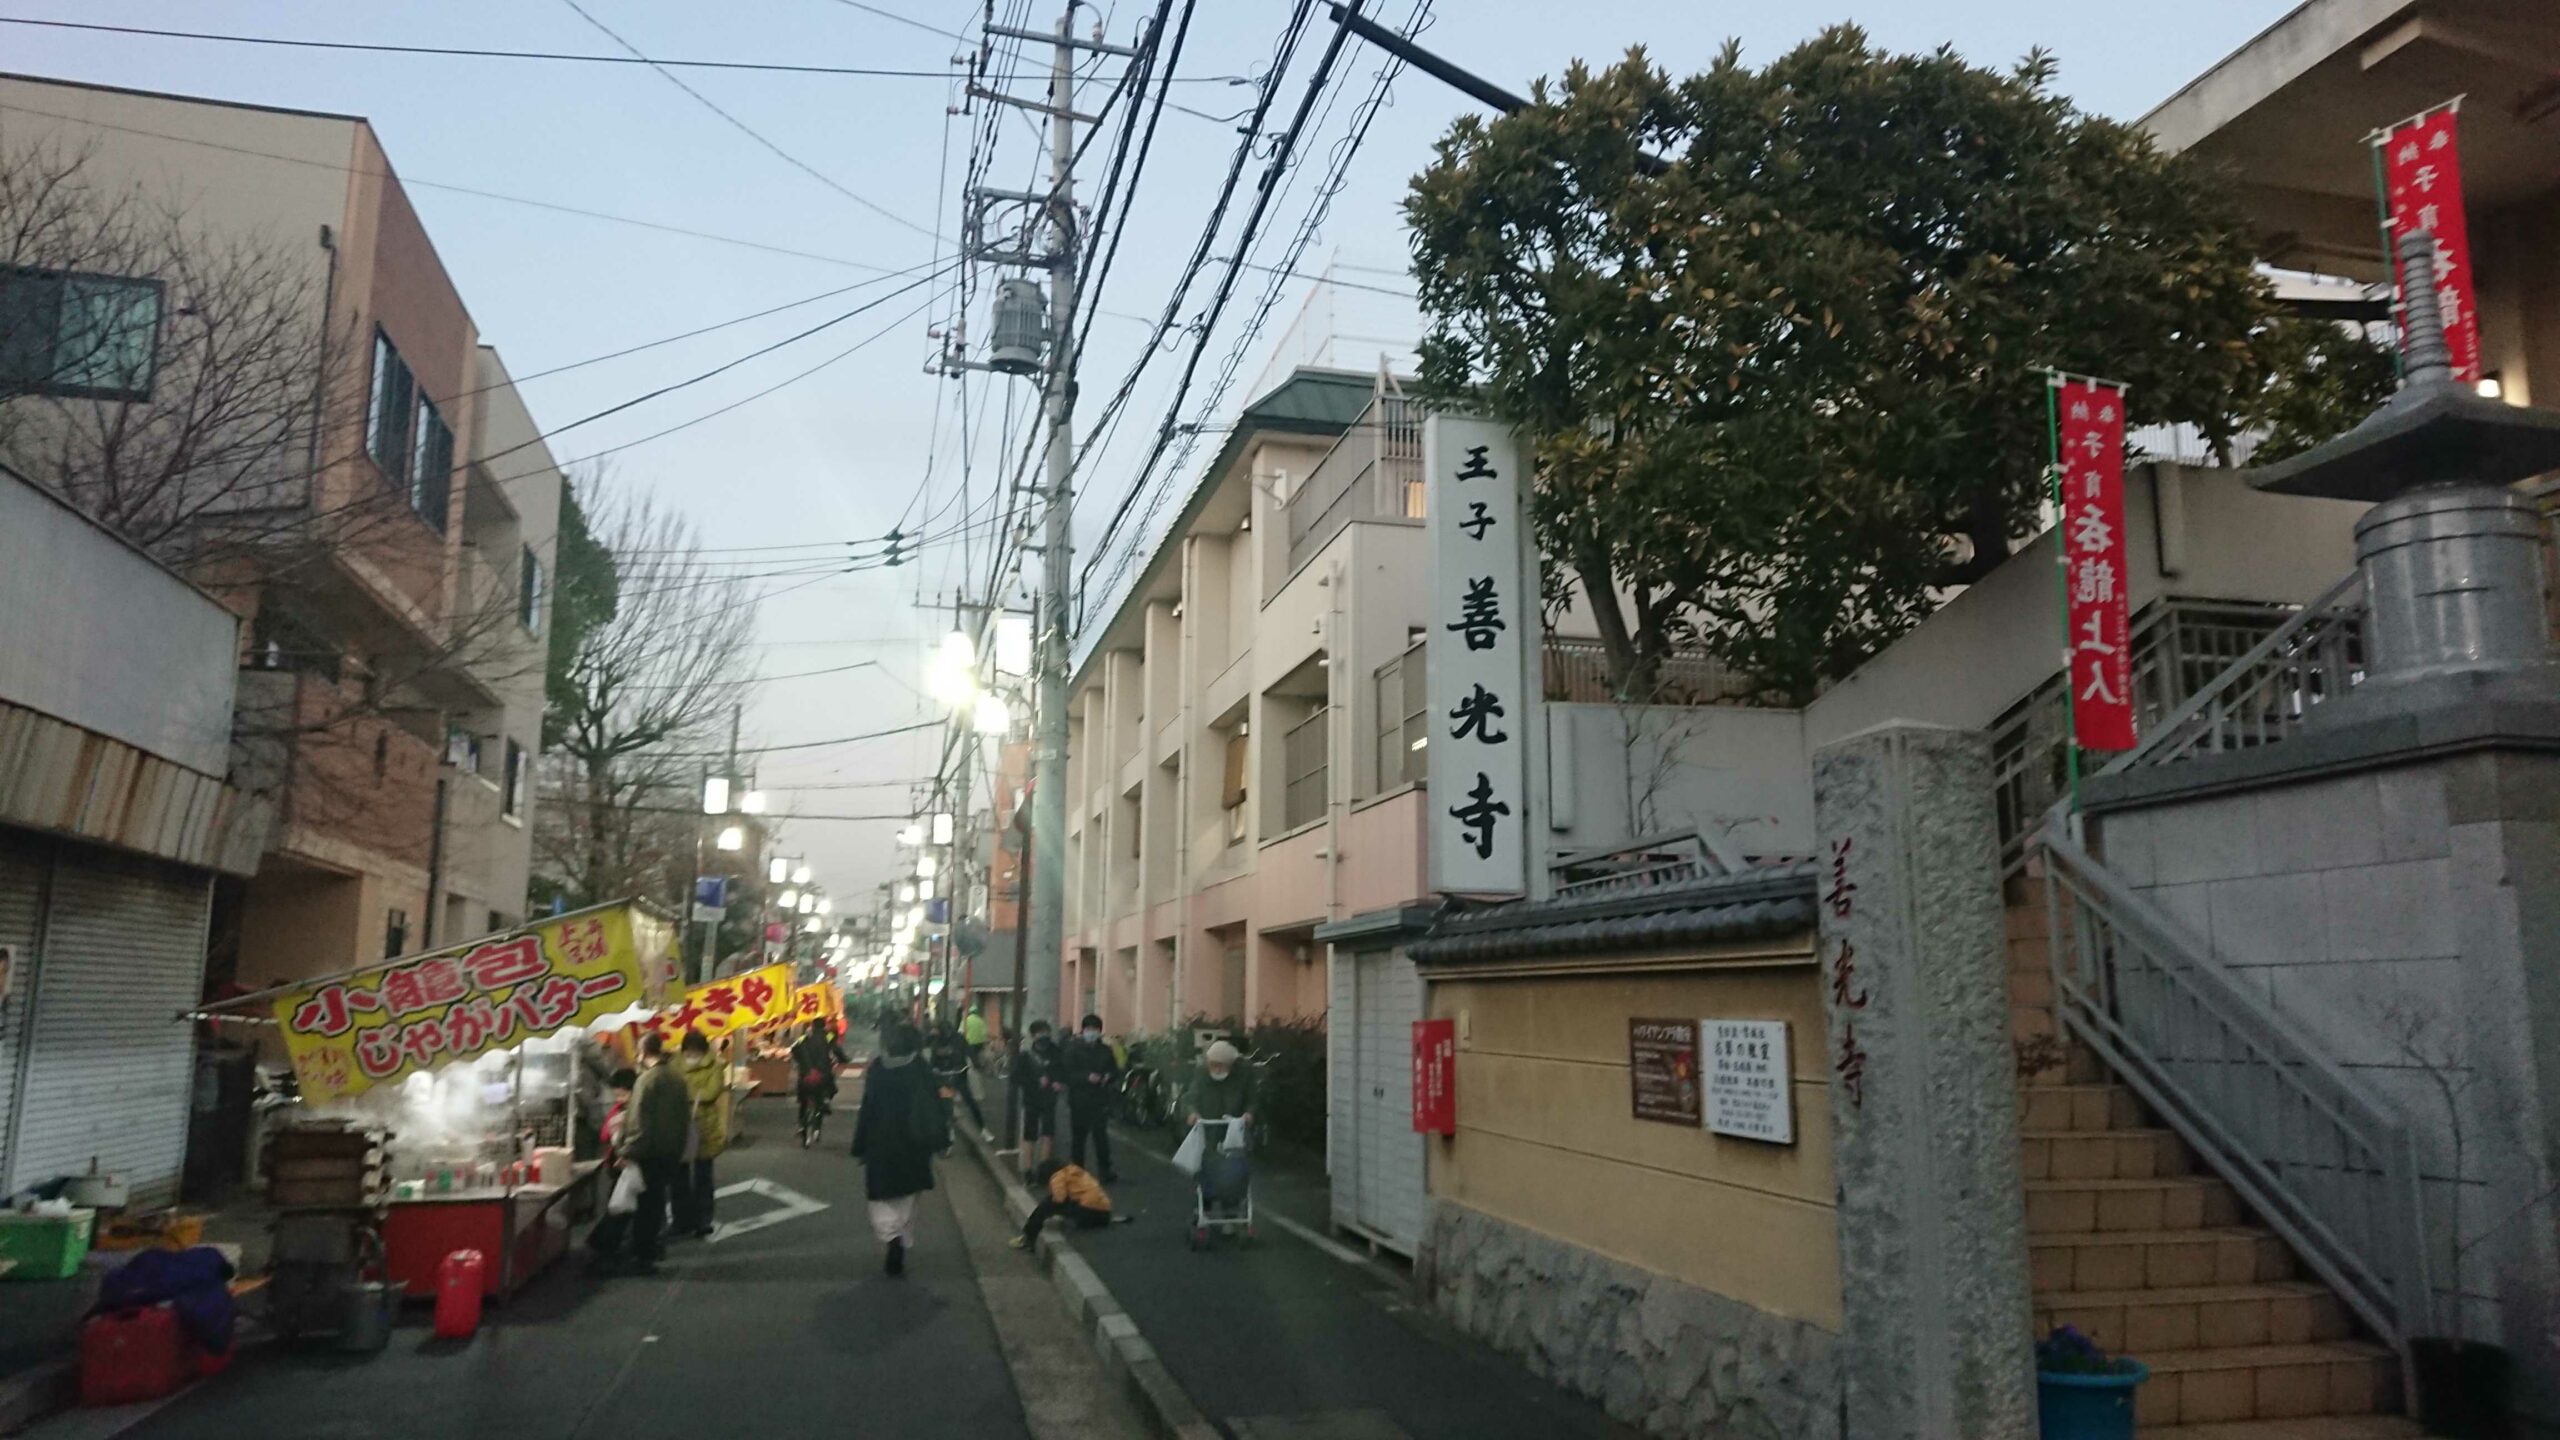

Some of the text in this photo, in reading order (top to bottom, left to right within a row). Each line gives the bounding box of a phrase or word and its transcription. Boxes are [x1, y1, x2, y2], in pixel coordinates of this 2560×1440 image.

[1446, 445, 1511, 861] 王子善光寺
[355, 971, 625, 1077] じゃがバター
[1824, 836, 1869, 1112] 善光寺
